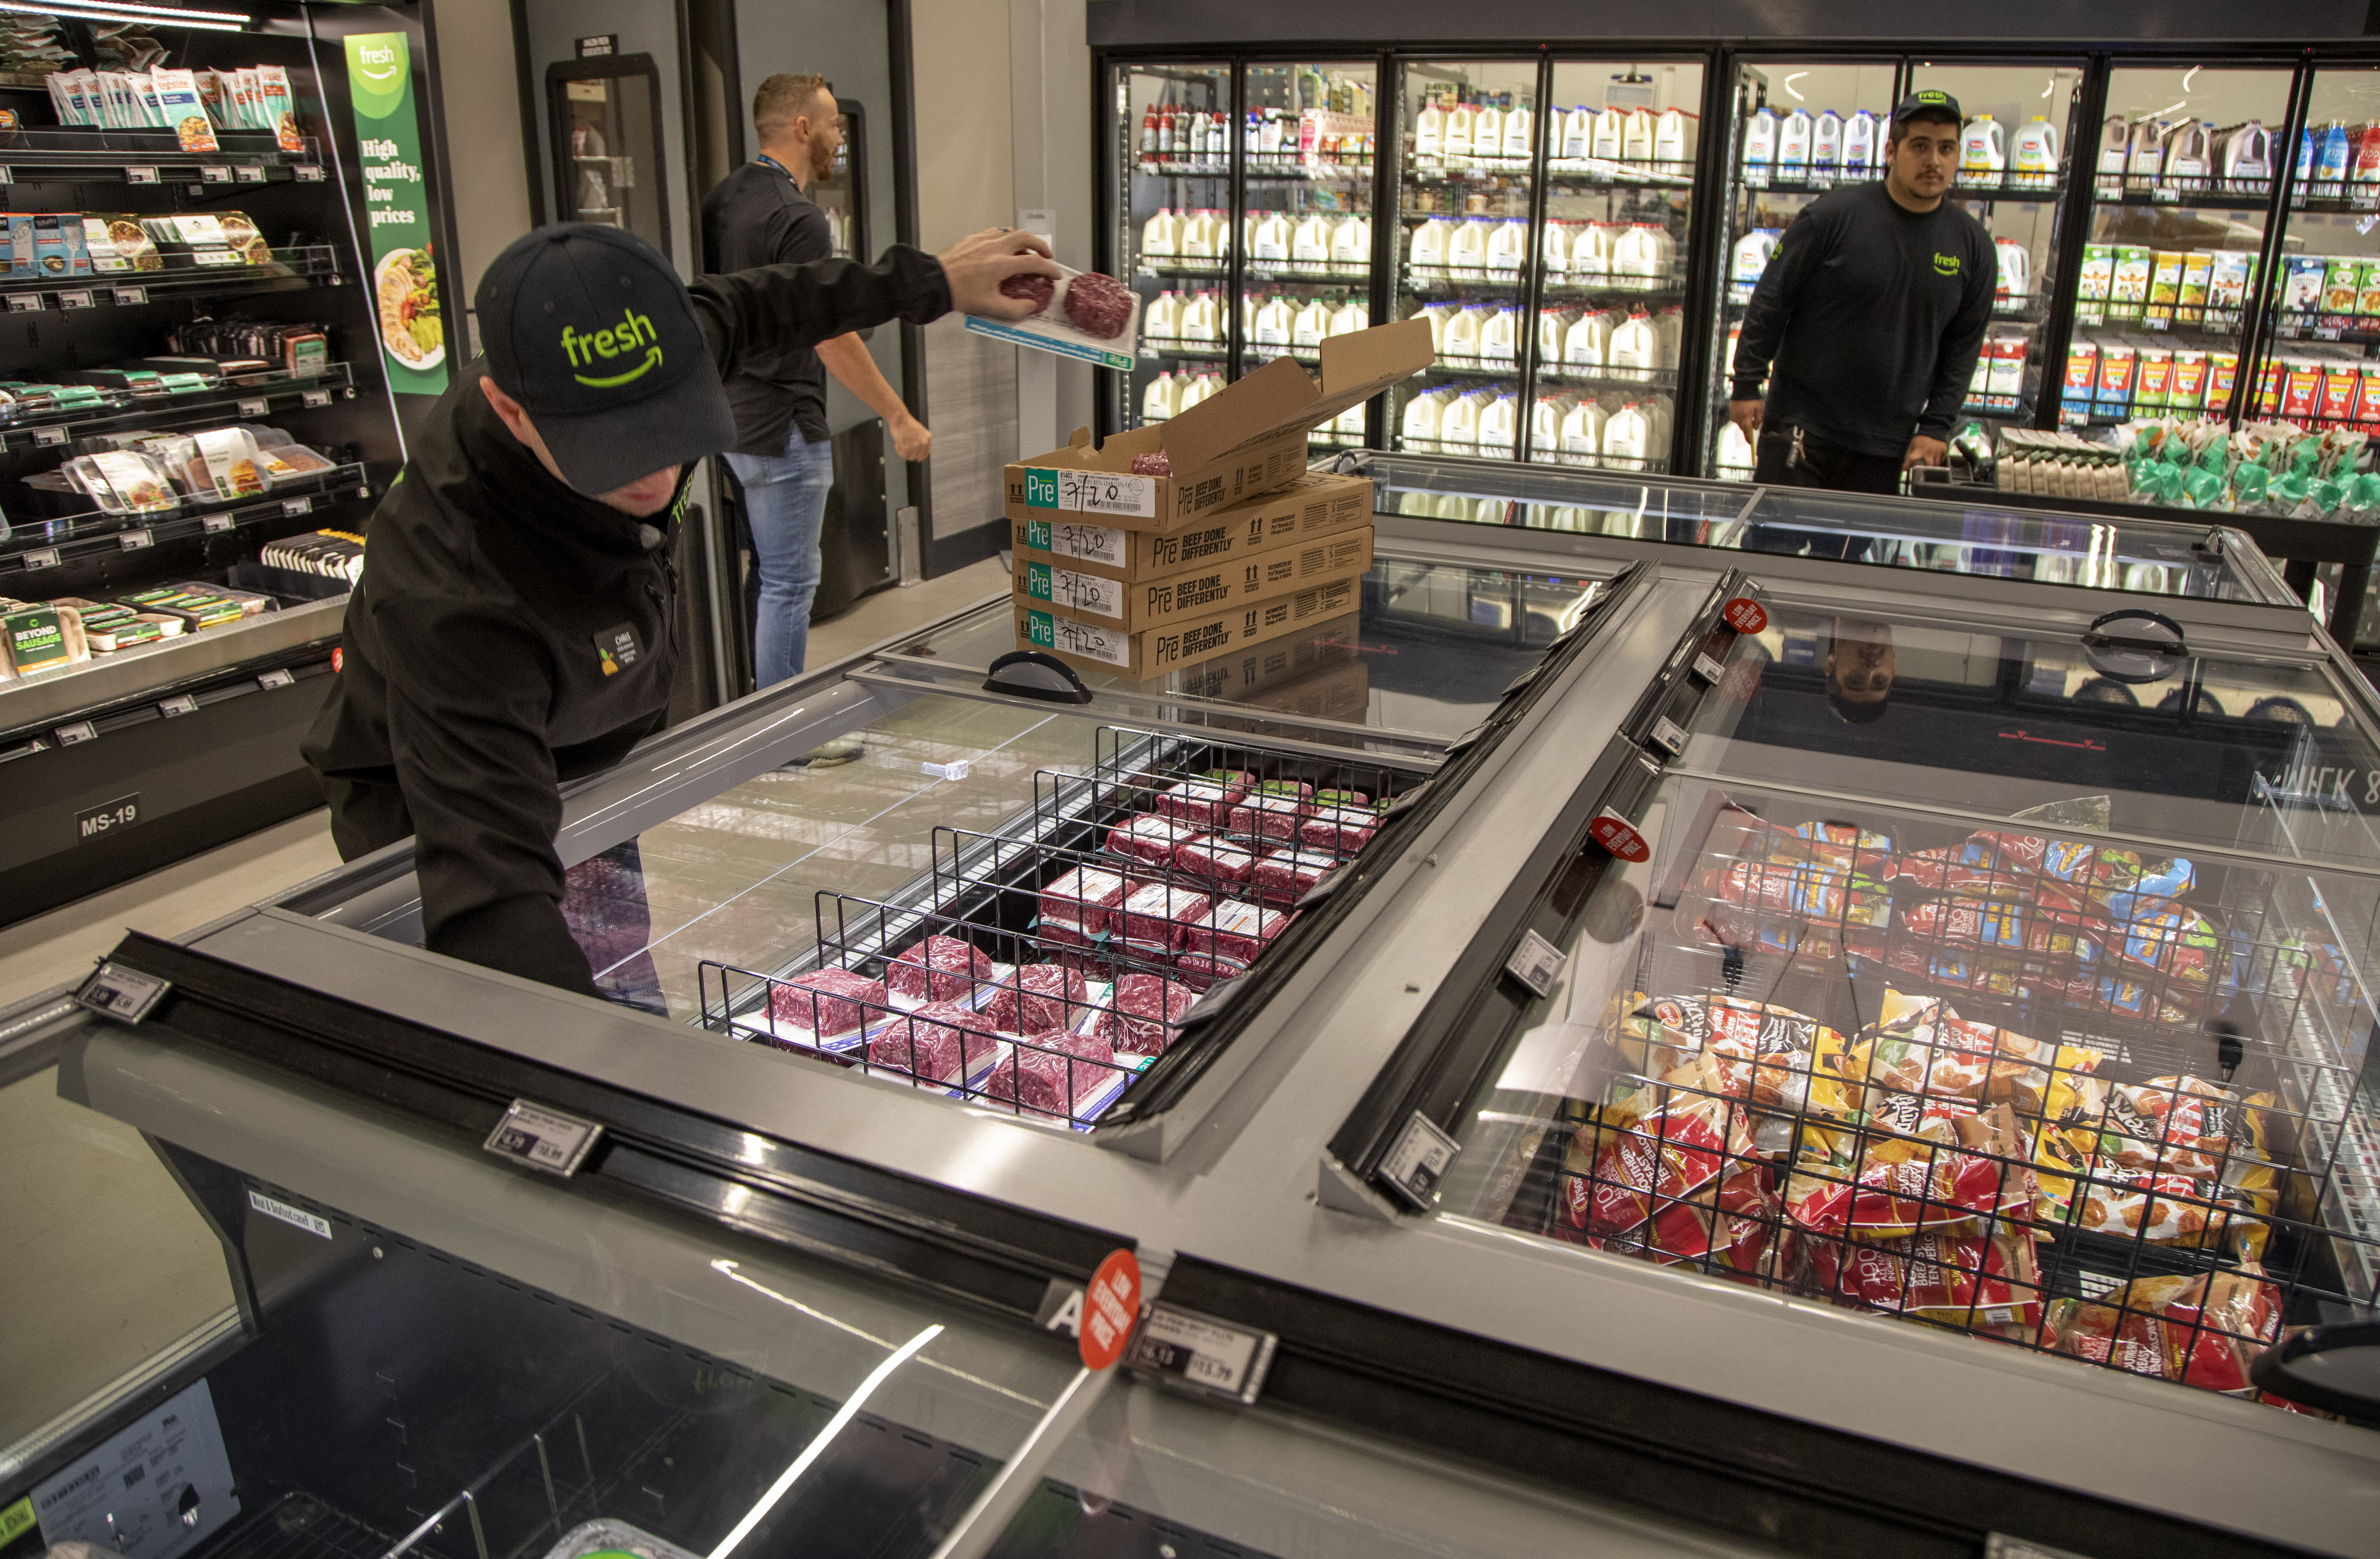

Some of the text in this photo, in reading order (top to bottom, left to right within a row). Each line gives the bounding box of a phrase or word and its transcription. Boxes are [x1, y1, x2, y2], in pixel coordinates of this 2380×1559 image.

[360, 45, 394, 64] fresh
[361, 140, 398, 161] High
[364, 161, 421, 182] quality,
[367, 185, 394, 202] low
[370, 209, 415, 227] prices
[1933, 252, 1960, 268] fresh
[560, 308, 657, 367] fresh
[346, 387, 356, 399] C
[359, 487, 369, 498] B
[1028, 475, 1054, 502] Pre
[1064, 474, 1119, 516] 7/20
[1177, 476, 1222, 518] Pre BEEF DONE
[1195, 487, 1226, 511] DIFFERENTLY
[1029, 520, 1049, 545] Pre
[1063, 526, 1105, 564] 7/20
[1153, 526, 1226, 568] Pre BEEF DONE
[1181, 537, 1232, 561] DIFFERENTLY
[1268, 561, 1287, 570] DISTRIBUTED
[1275, 567, 1286, 575] Brands
[1030, 568, 1049, 595] Pre
[1060, 573, 1100, 617] 7/20
[1149, 574, 1221, 617] Pre BEEF DONE
[1177, 584, 1231, 610] DIFFERENTLY
[1054, 615, 1064, 624] 61402
[1732, 604, 1745, 617] LOW
[1734, 604, 1758, 628] EVERYDAY
[1745, 614, 1762, 629] PRICE
[15, 625, 57, 641] BEYOND
[1031, 616, 1051, 642] Pre
[16, 633, 62, 650] SAUSAGE
[1156, 621, 1223, 666] Pre BEEF DONE
[1182, 630, 1231, 658] DIFFERENTLY
[1639, 757, 1661, 775] A
[82, 805, 136, 837] MS-19
[1600, 823, 1617, 838] LOW
[1606, 828, 1634, 851] EVERYDAY
[1621, 840, 1642, 856] PRICE
[252, 1193, 270, 1211] Meat &
[1046, 1289, 1084, 1339] A
